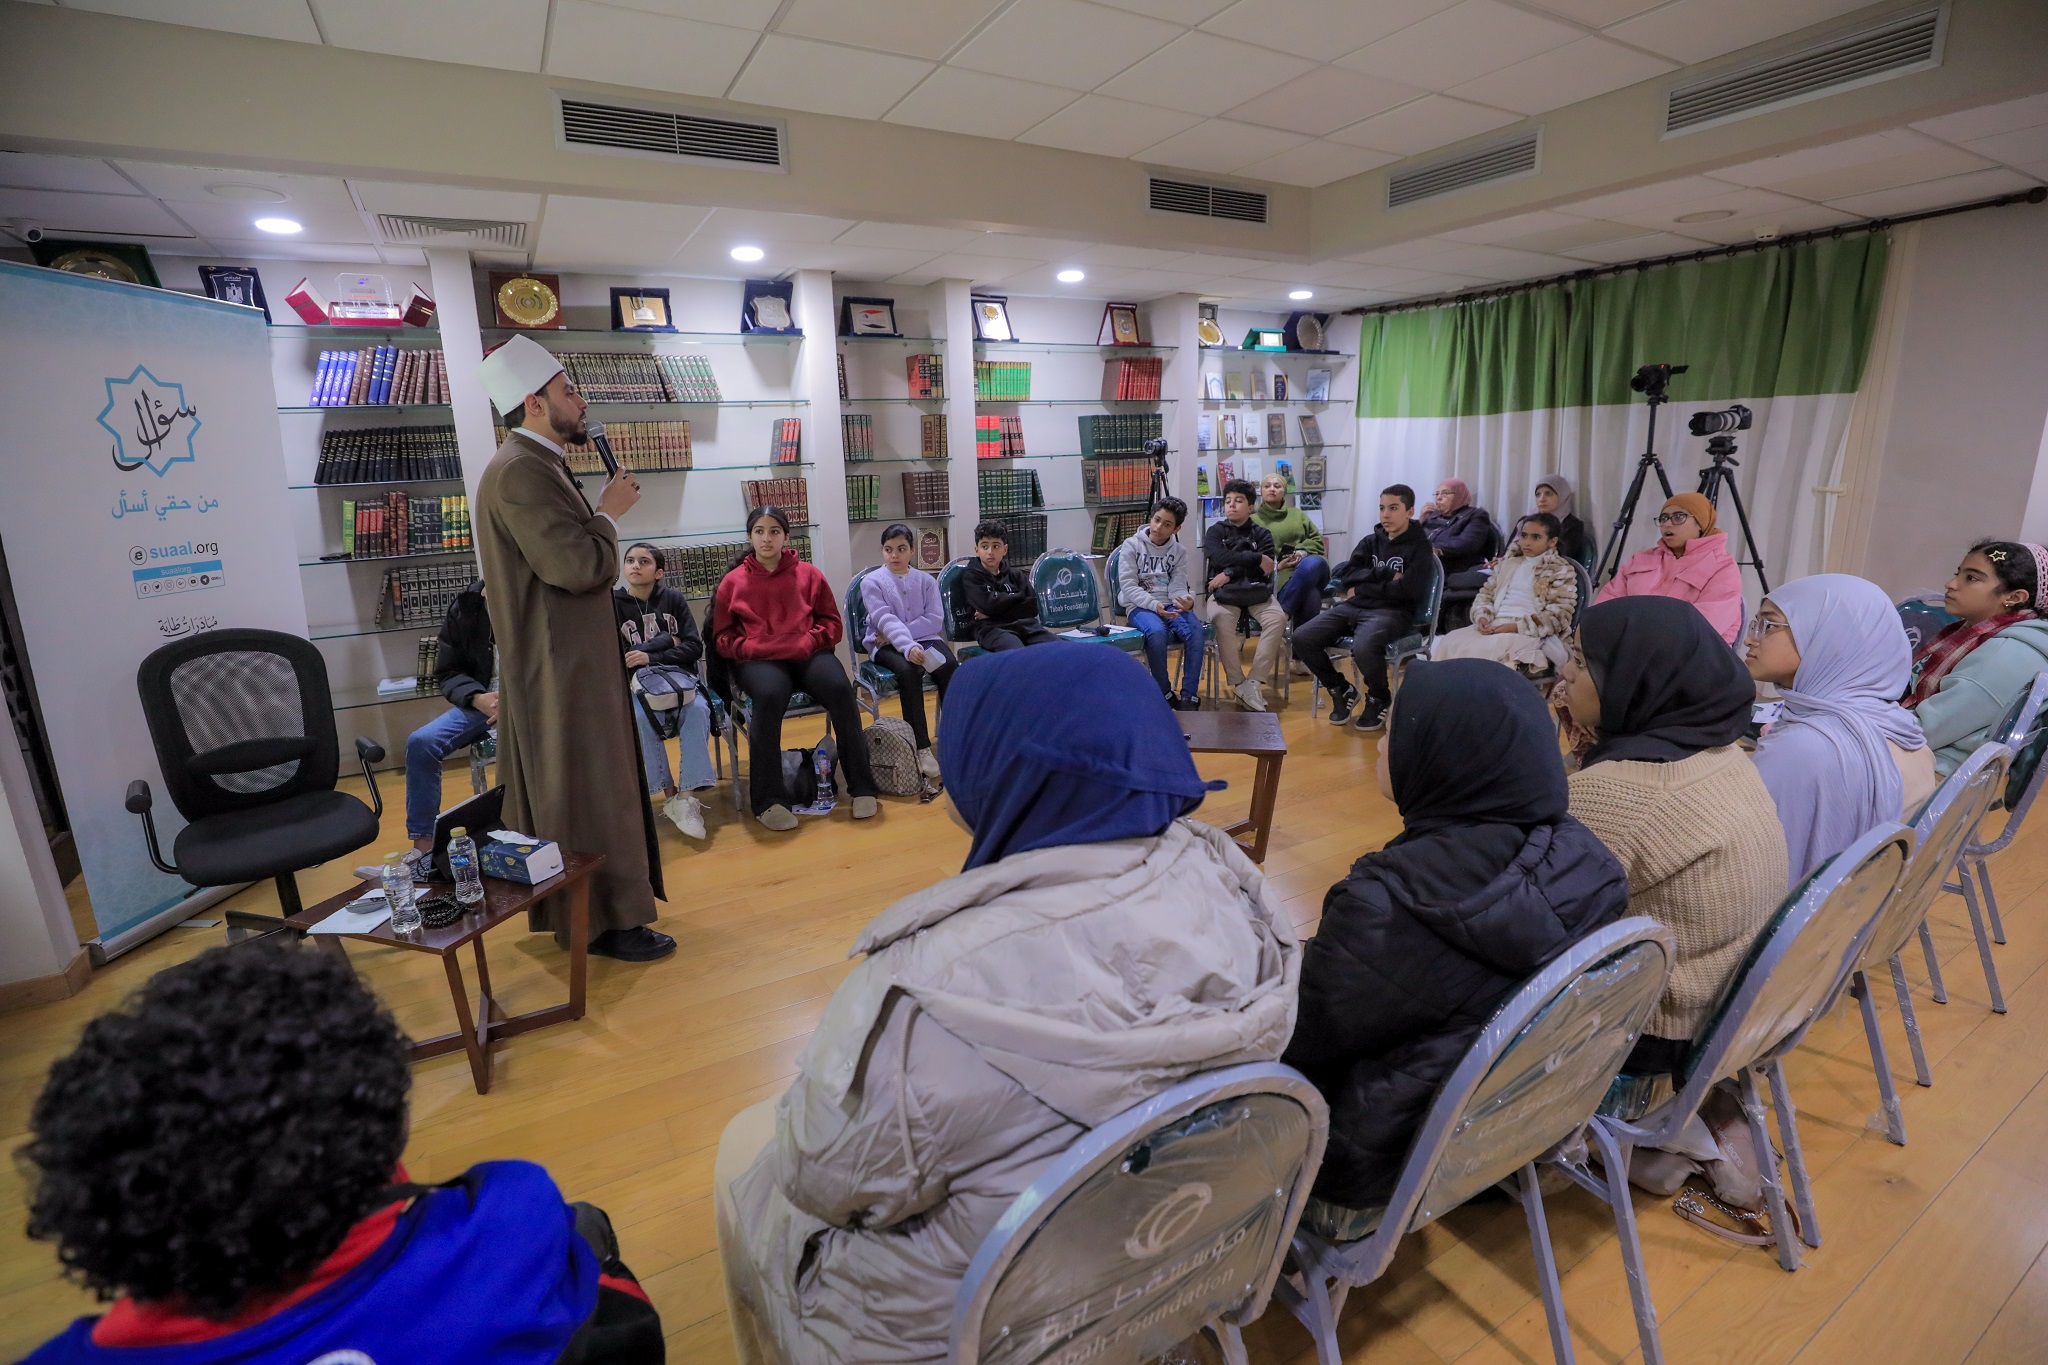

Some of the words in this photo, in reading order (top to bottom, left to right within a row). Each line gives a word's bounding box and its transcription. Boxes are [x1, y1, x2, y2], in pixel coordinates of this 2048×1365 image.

[112, 389, 197, 471] سؤال
[111, 489, 149, 519] أسأل
[155, 495, 192, 521] حقي
[197, 495, 219, 513] من
[150, 541, 219, 559] suaal.org
[160, 565, 192, 576] suaalorg
[1064, 601, 1090, 612] Foundation
[621, 613, 679, 646] GAP
[1115, 1268, 1235, 1343] Foundation
